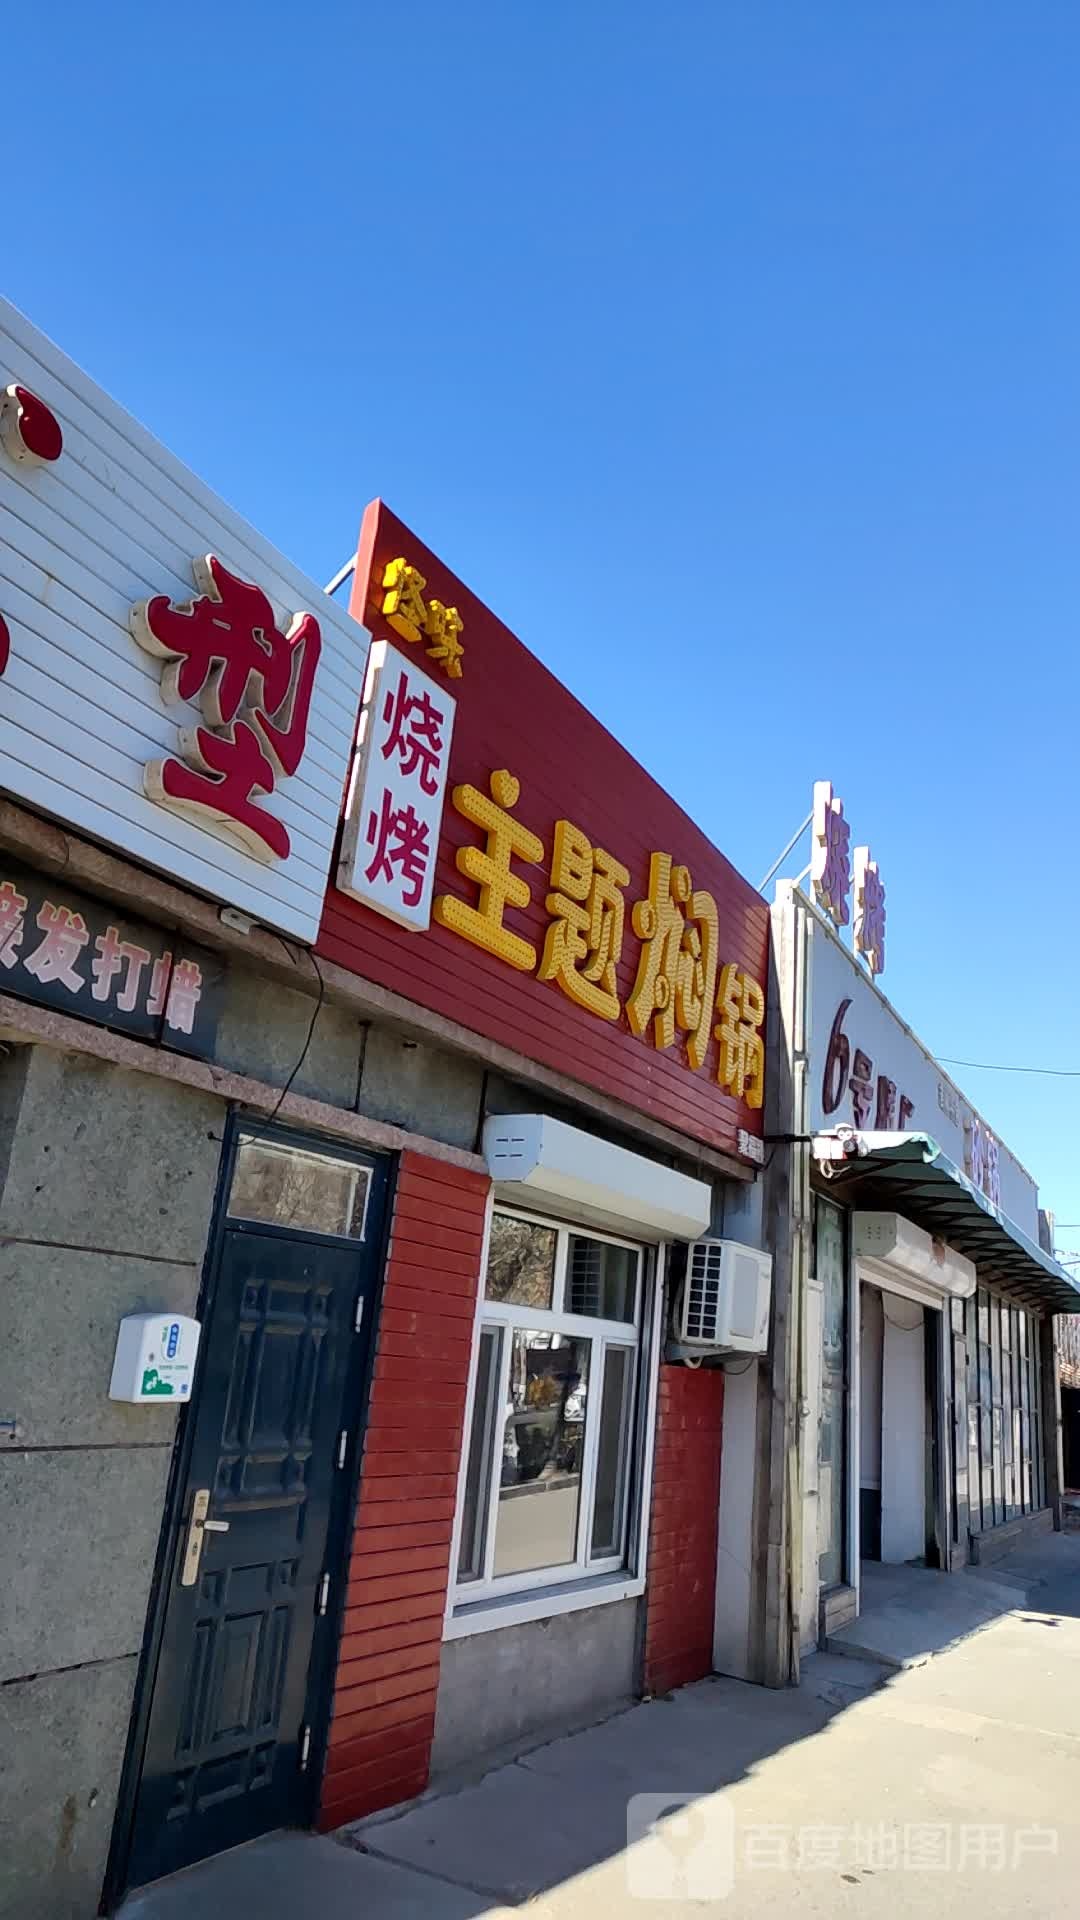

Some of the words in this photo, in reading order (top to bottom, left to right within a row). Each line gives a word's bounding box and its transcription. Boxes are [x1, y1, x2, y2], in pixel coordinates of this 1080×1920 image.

[365, 671, 444, 907] 烧烤
[433, 768, 765, 1109] 主题焖锅
